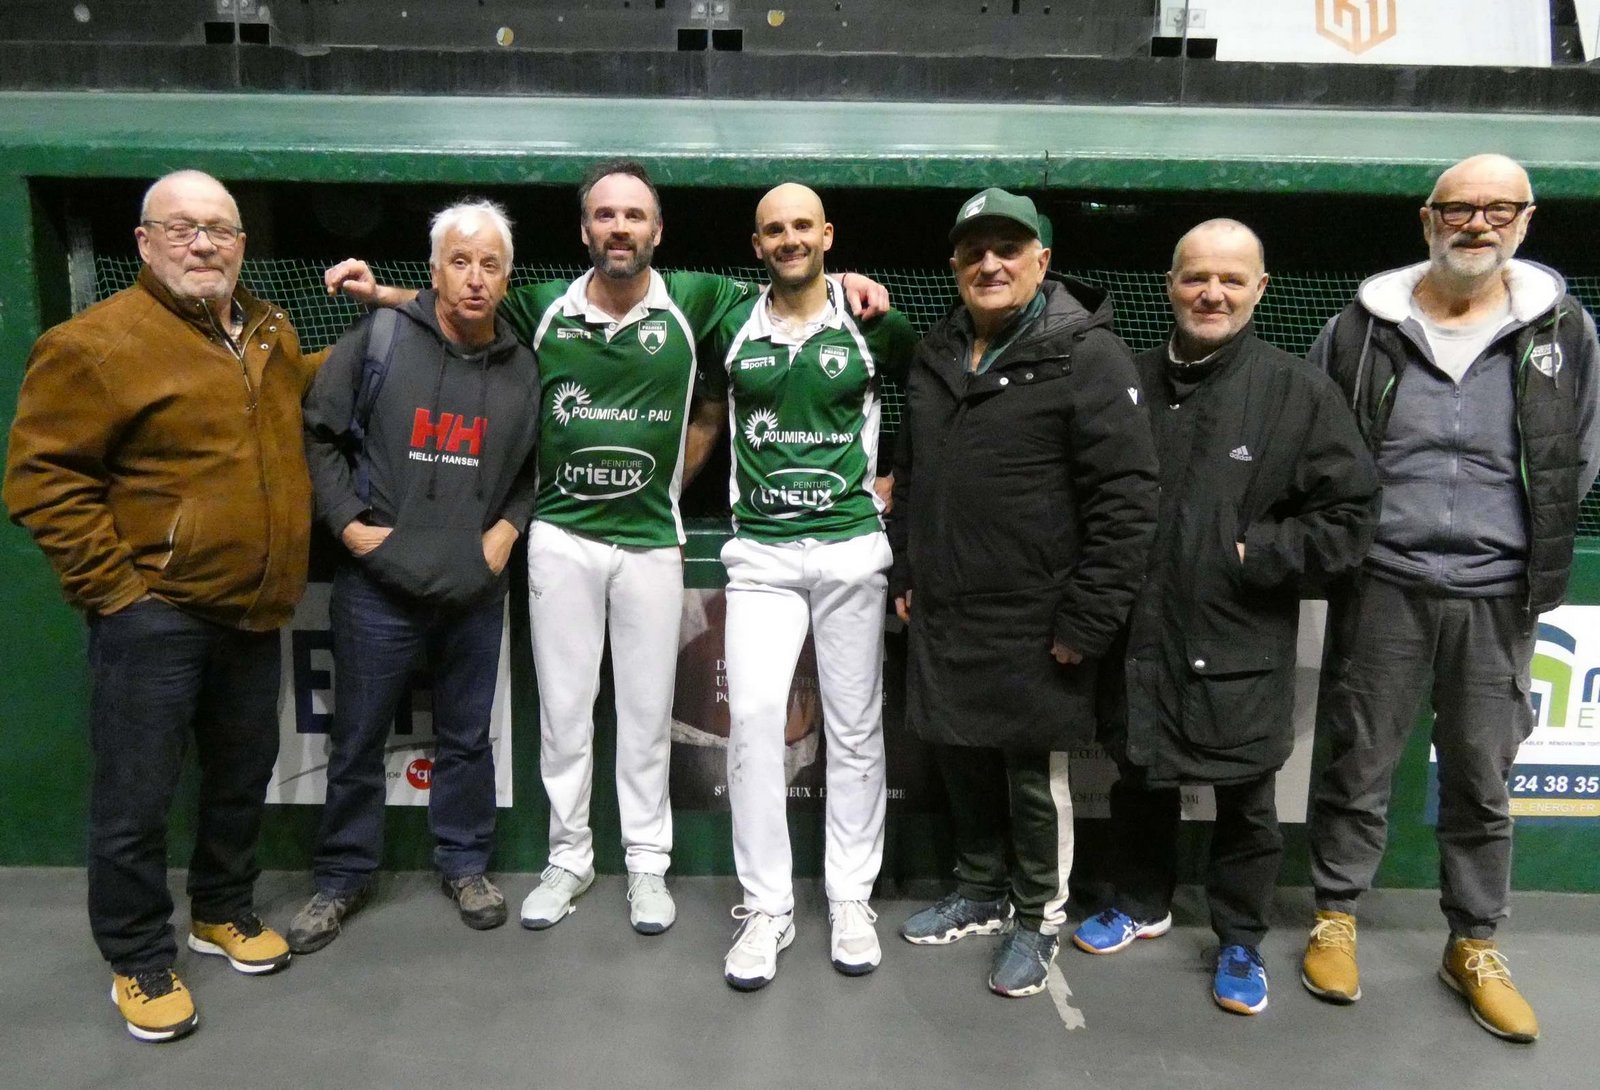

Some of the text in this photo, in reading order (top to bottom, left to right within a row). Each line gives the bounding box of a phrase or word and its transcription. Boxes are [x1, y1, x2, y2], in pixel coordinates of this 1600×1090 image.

[571, 406, 639, 421] POUMIRAU
[648, 409, 672, 422] PAU
[411, 408, 487, 454] HH
[762, 430, 823, 444] POUMIRAU
[831, 432, 854, 444] PAU
[442, 454, 480, 467] HANSEN
[601, 459, 643, 468] PEINTURE
[793, 480, 831, 489] PEINTURE
[1512, 775, 1600, 794] 24 38 35
